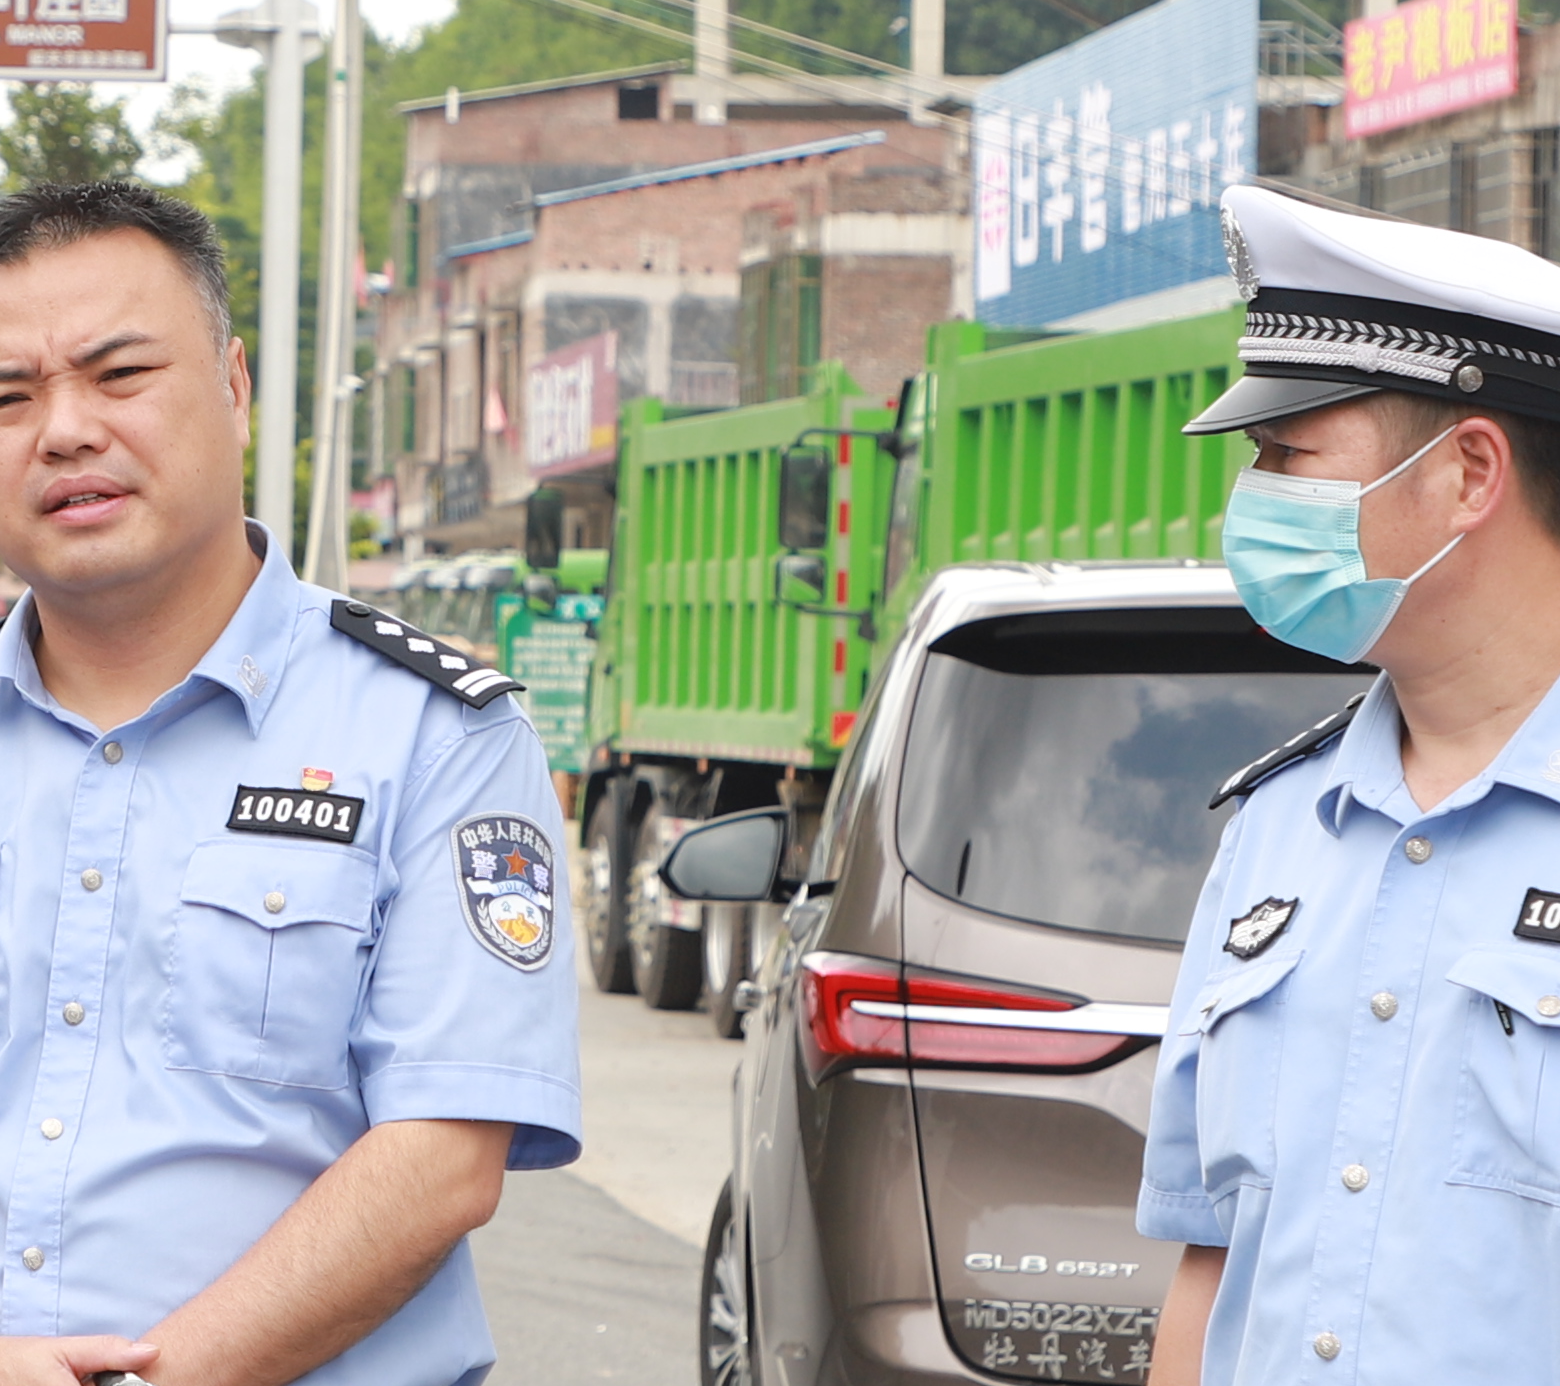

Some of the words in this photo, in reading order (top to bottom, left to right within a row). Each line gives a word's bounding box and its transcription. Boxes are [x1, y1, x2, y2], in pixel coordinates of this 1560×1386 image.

[5, 24, 85, 46] MANOR
[238, 795, 351, 832] 100401
[471, 850, 497, 879] 警
[1055, 1260, 1140, 1278] 652T
[983, 1332, 1151, 1379] 牡丹汽车
